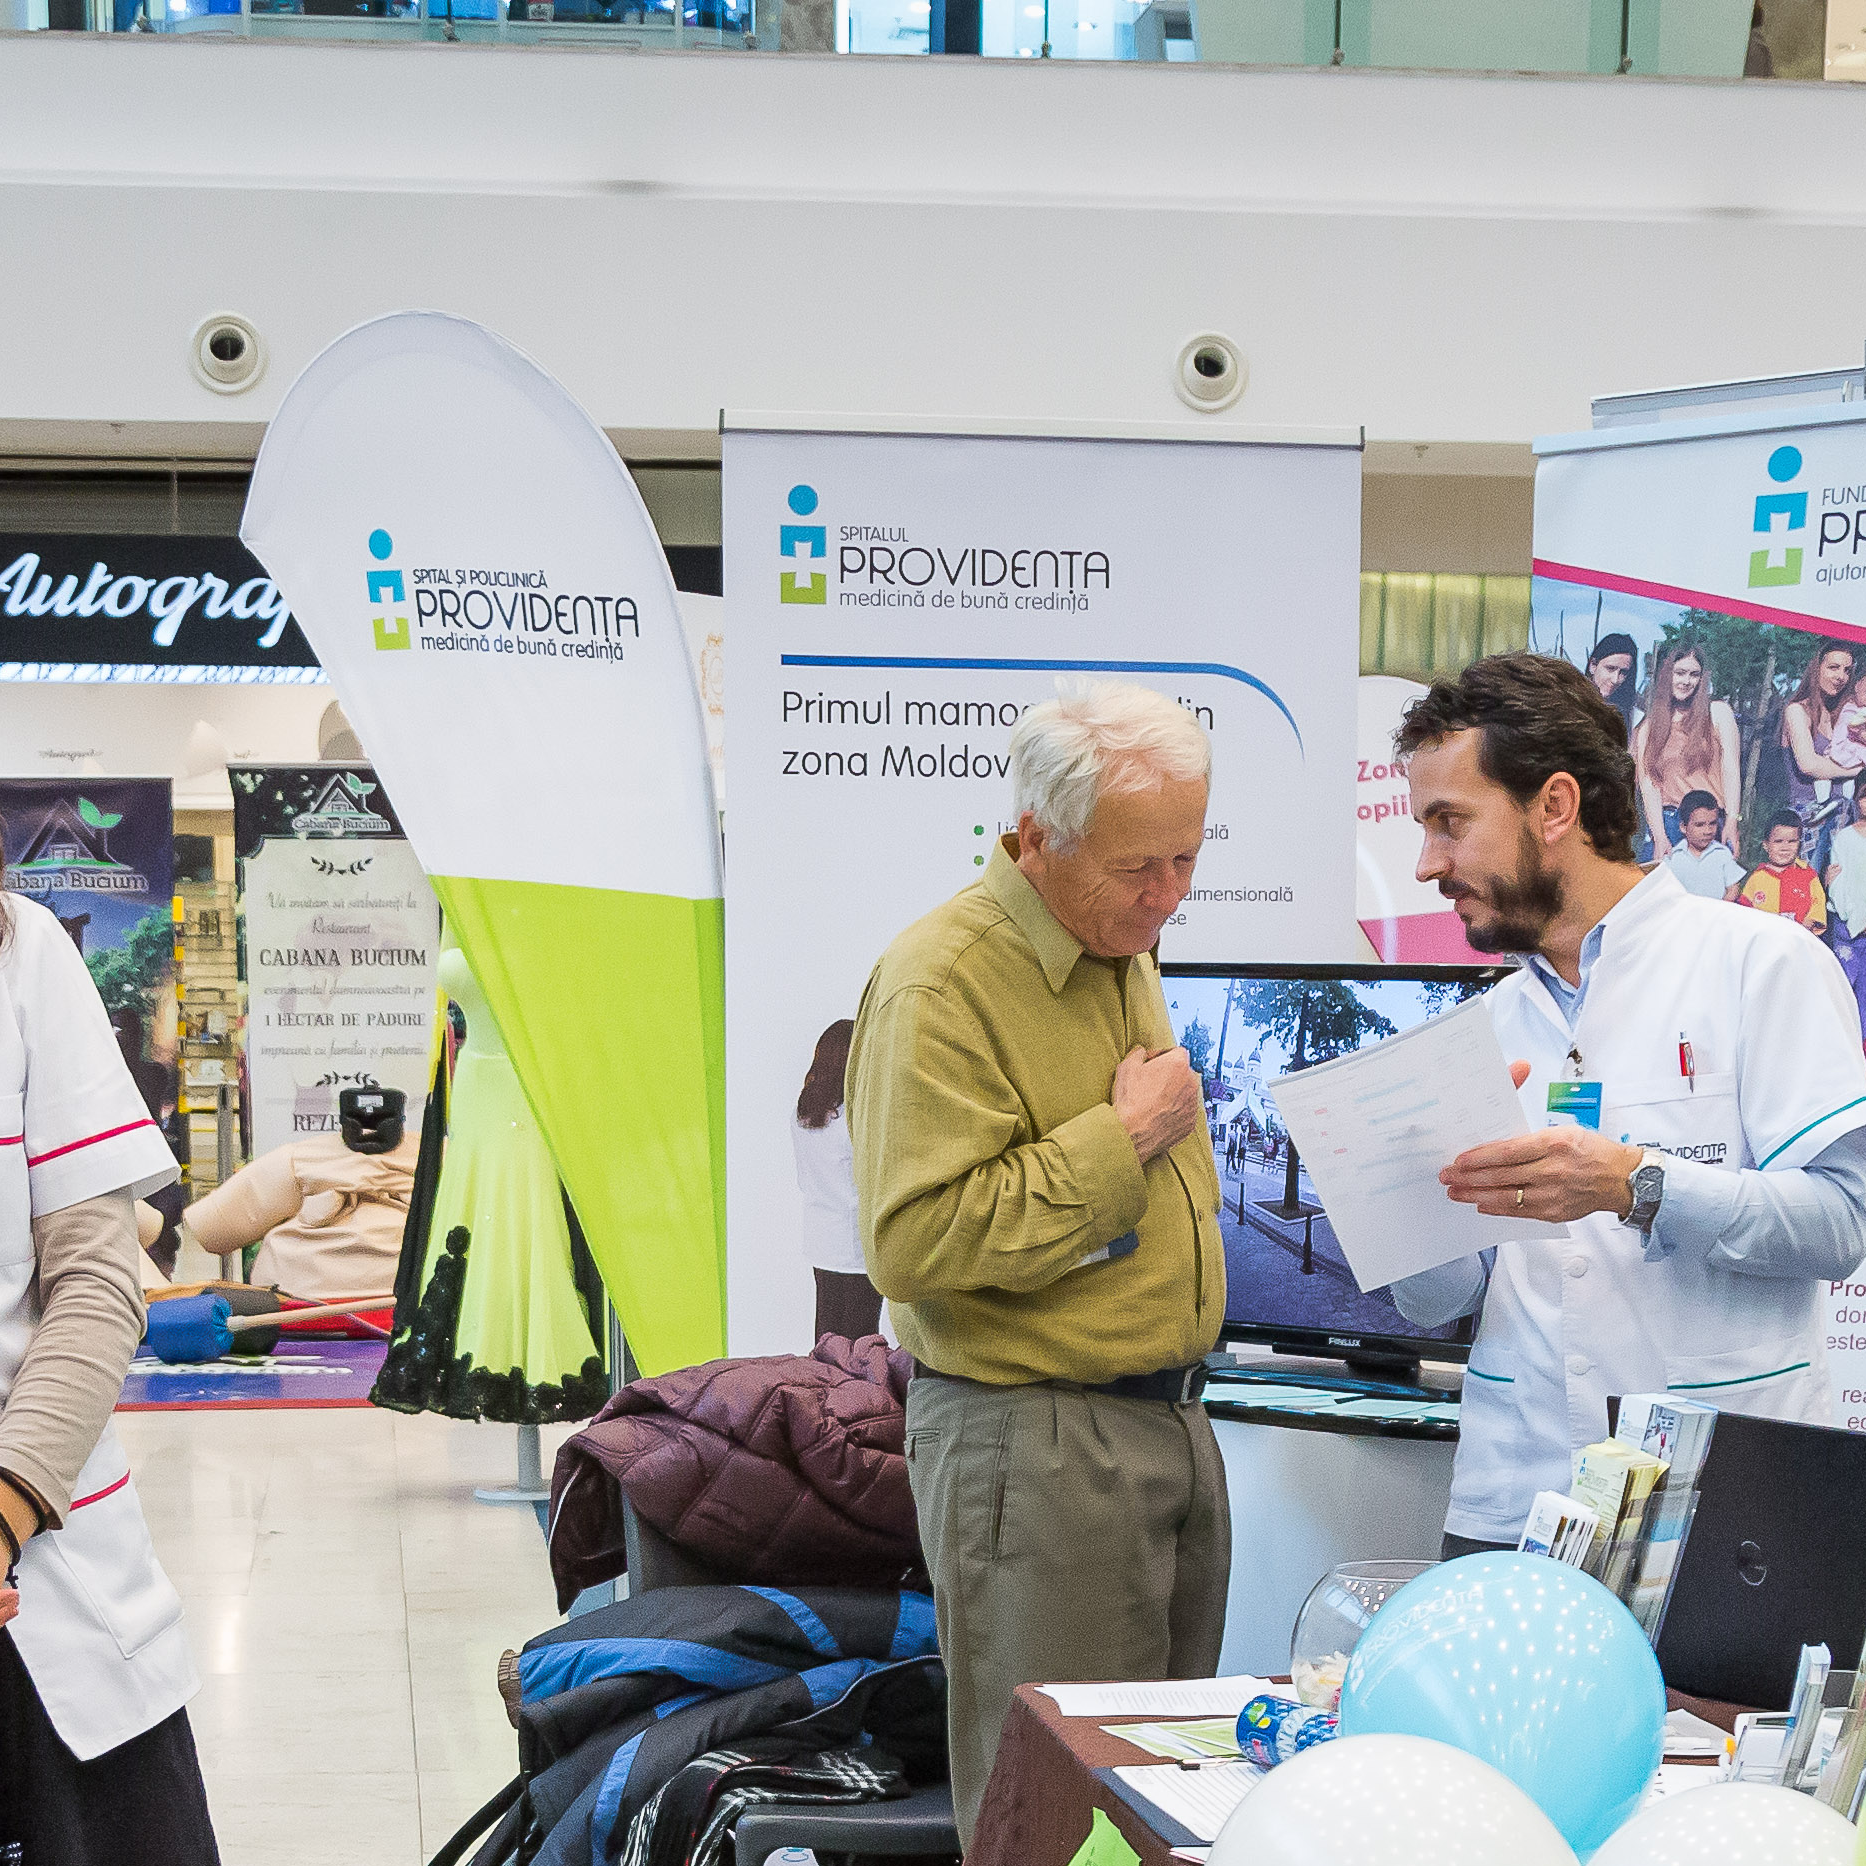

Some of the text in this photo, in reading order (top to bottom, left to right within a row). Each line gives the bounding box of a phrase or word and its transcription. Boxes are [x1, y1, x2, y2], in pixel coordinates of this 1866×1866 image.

[839, 526, 909, 543] SPITALUL
[412, 569, 453, 585] SPITAL
[469, 570, 548, 588] POLICLINICĂ
[839, 589, 925, 608] medicină
[931, 590, 954, 608] de
[961, 590, 1009, 610] bună
[420, 632, 490, 651] medicină
[493, 635, 515, 653] de
[517, 635, 558, 656] bună
[783, 691, 891, 726] Primul
[782, 744, 1011, 779] zona Moldov
[259, 948, 428, 967] CABANA BUCIUM
[277, 1013, 335, 1027] HECTAR
[341, 1013, 361, 1027] DE
